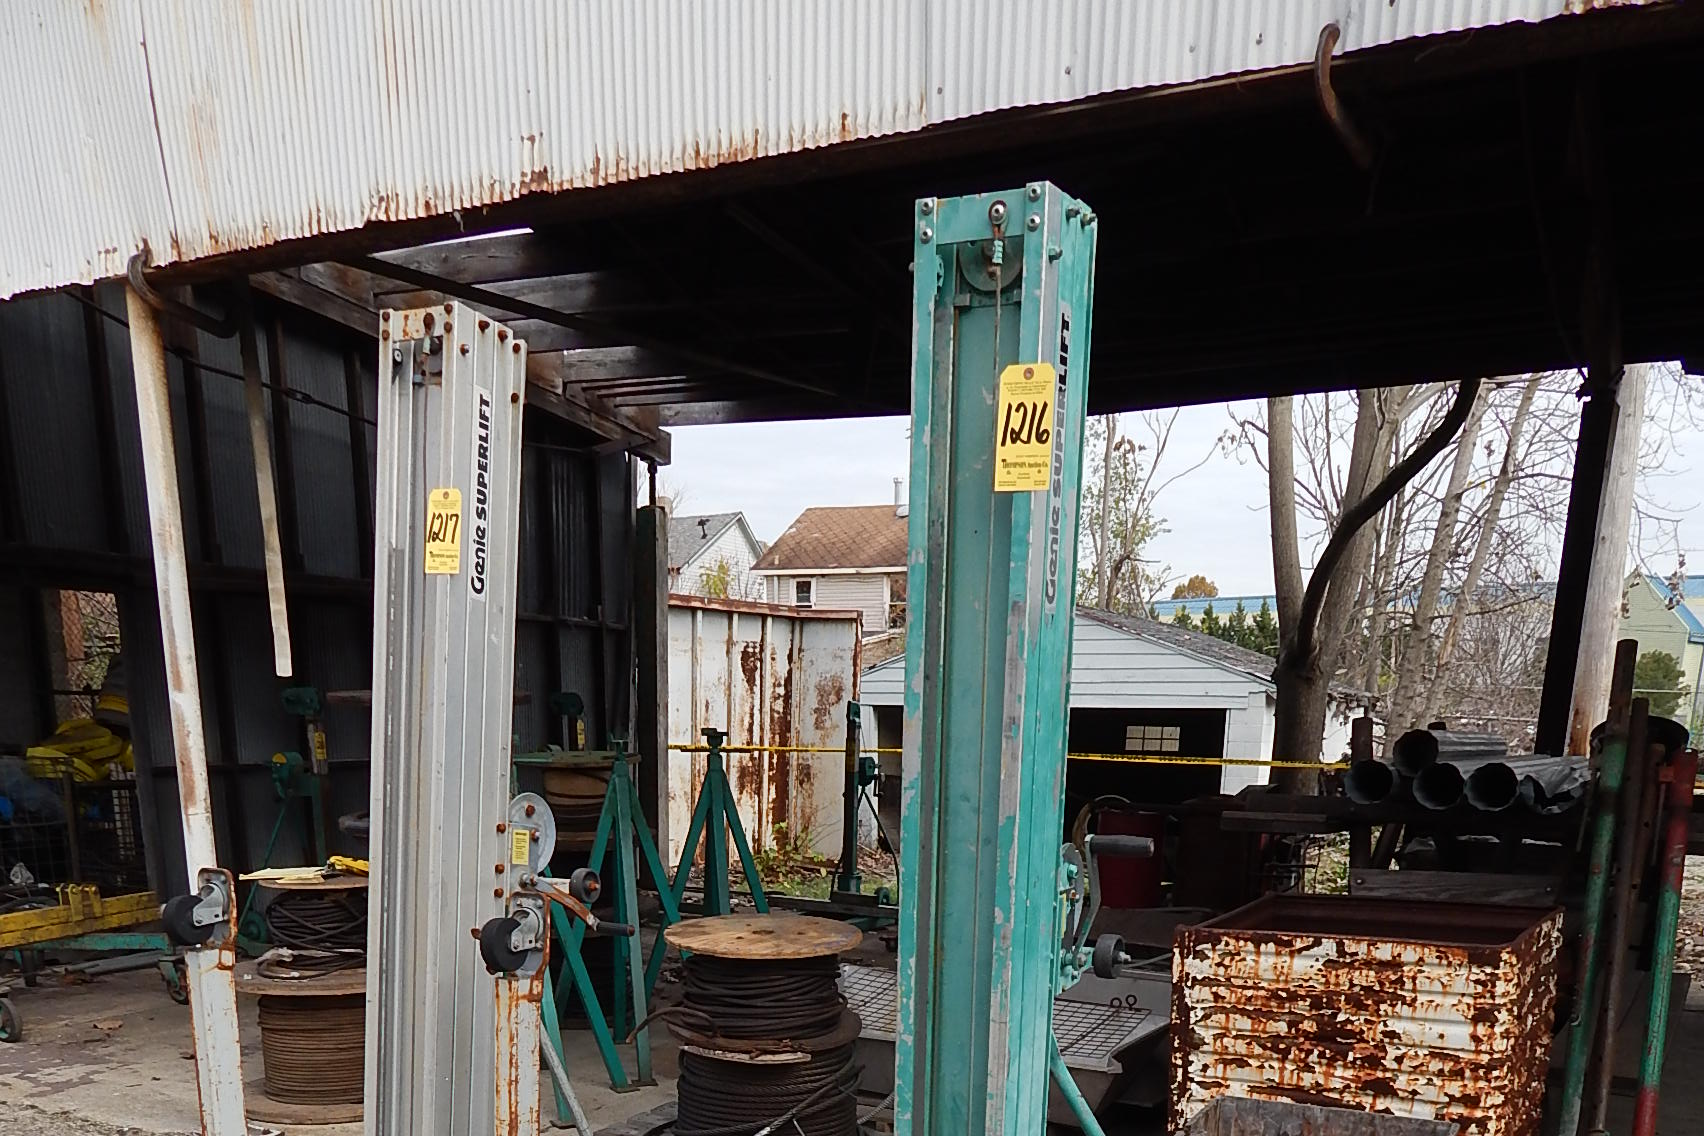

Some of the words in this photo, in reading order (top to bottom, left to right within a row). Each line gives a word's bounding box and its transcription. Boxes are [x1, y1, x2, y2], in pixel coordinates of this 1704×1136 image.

[1001, 400, 1050, 447] 1216
[1052, 312, 1071, 498] SUPERLIFT
[475, 394, 491, 522] SUPERLIFT
[427, 511, 460, 545] 1217
[471, 528, 486, 595] Genie
[1046, 507, 1060, 604] Genie
